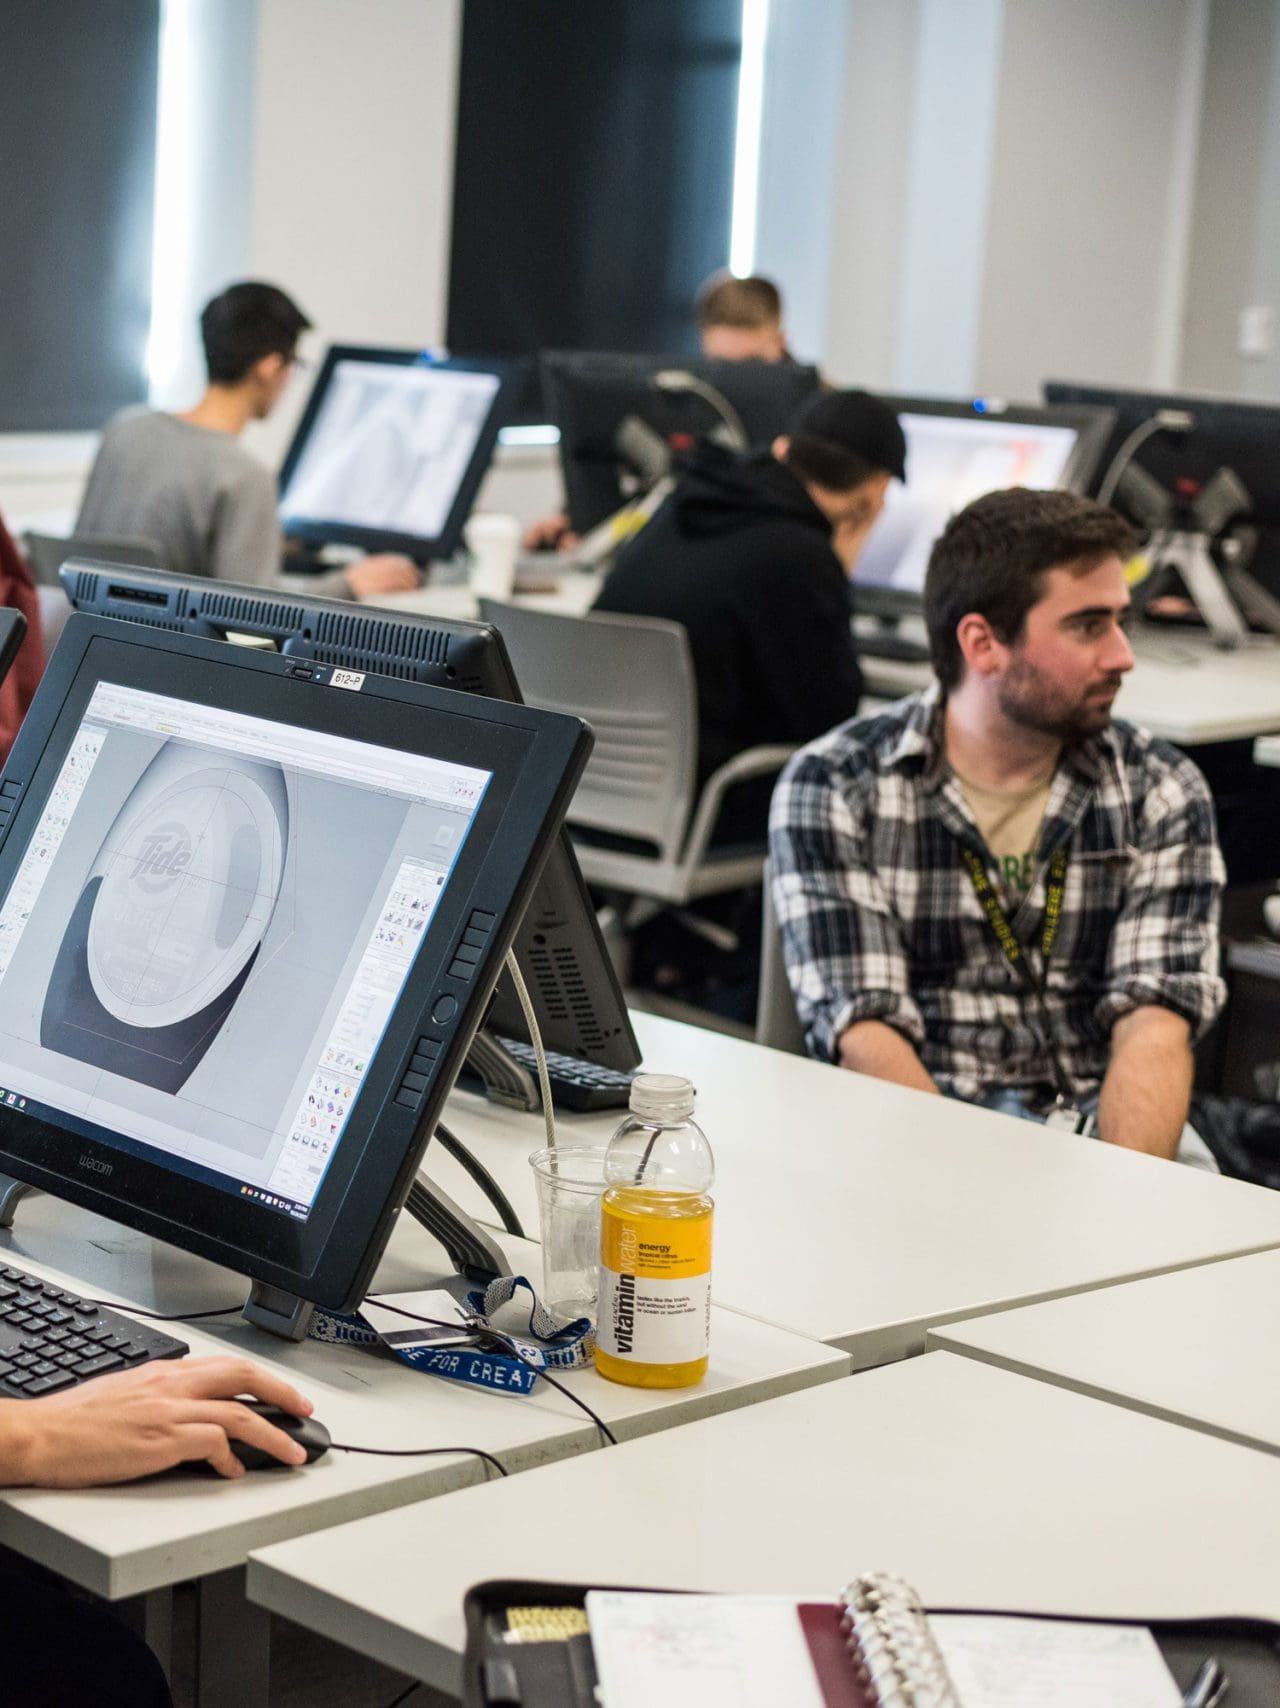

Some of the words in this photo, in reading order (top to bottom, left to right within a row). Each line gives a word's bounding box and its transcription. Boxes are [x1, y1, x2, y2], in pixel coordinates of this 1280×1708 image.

[335, 674, 361, 685] 612-P
[128, 834, 192, 880] Tide
[638, 1243, 671, 1253] energy
[427, 1355, 460, 1372] FOR
[470, 1360, 536, 1388] CREAT
